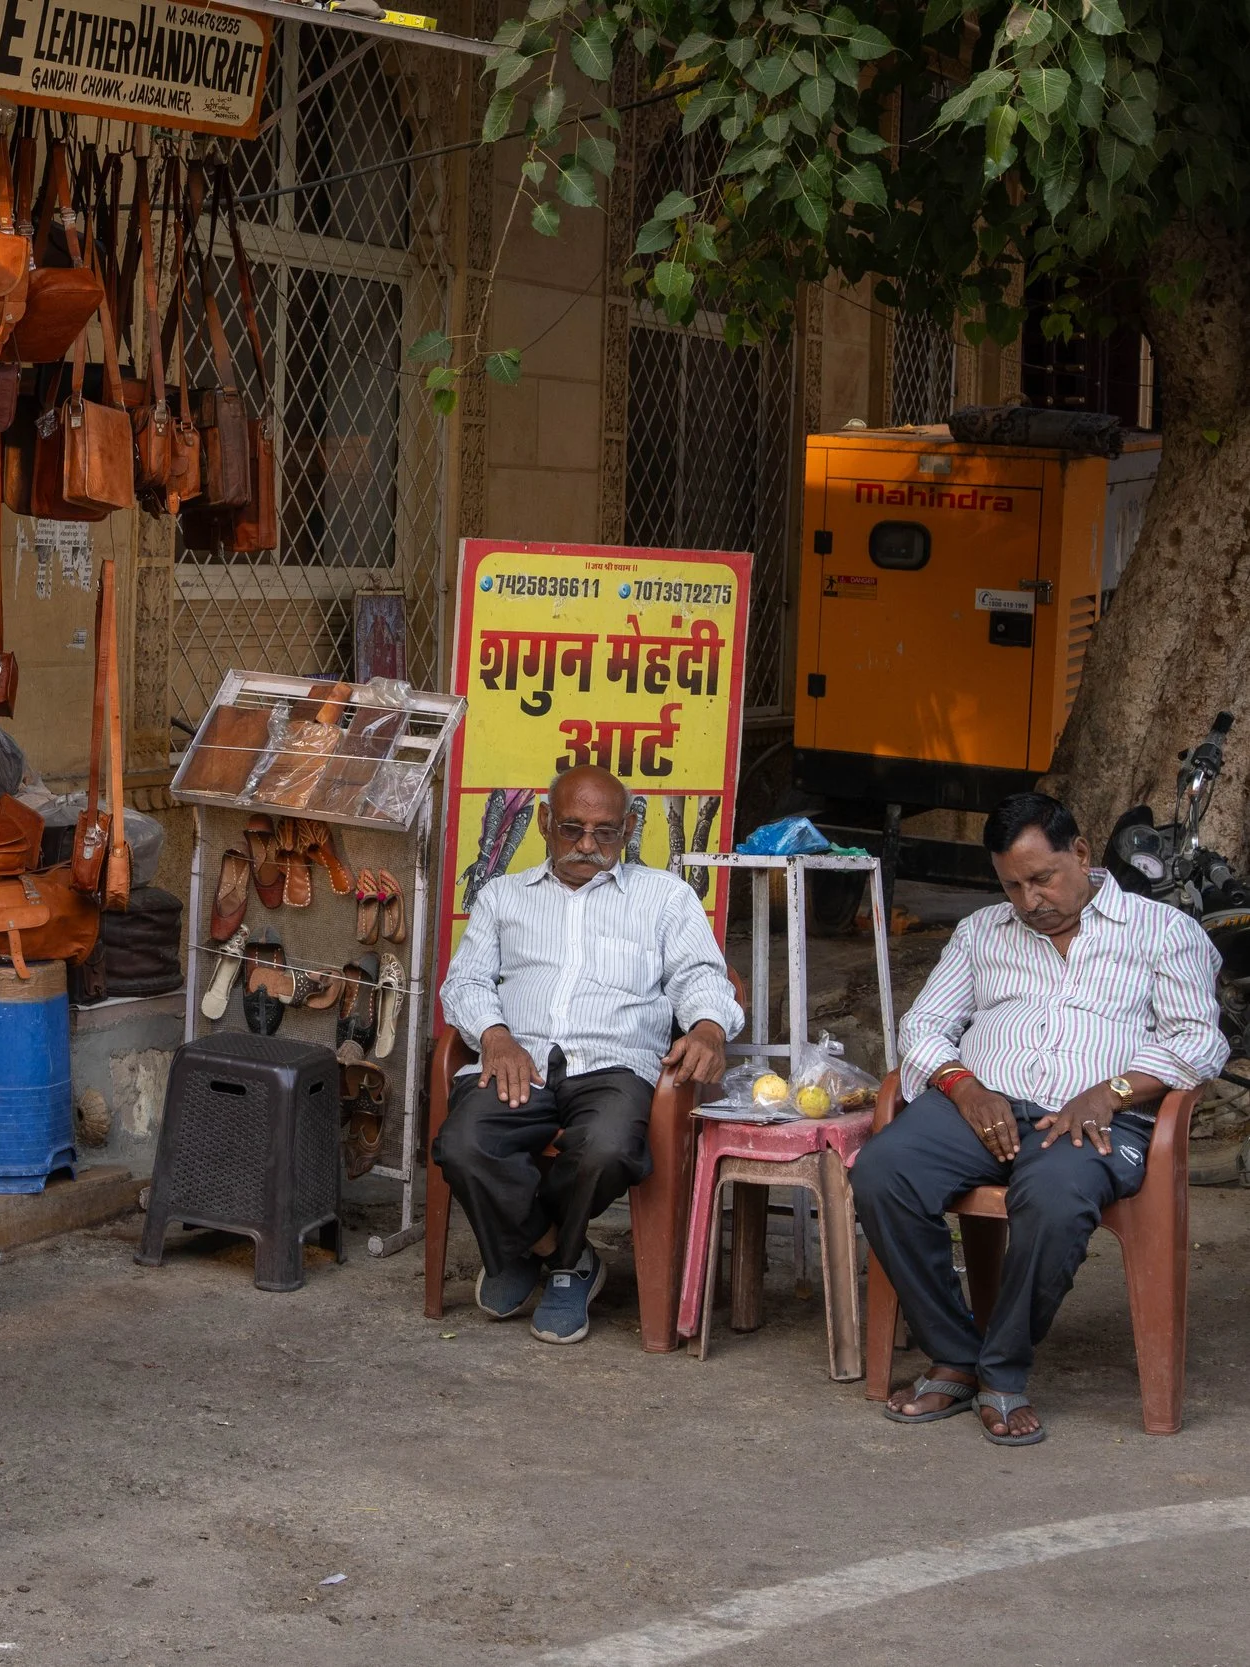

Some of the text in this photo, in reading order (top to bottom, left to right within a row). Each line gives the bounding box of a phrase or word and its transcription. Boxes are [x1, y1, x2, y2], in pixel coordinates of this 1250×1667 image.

[31, 67, 78, 92] GANDHI
[496, 574, 733, 604] 7425836611 7073972275
[479, 630, 599, 717] शगुन
[555, 703, 683, 777] आर्ट
